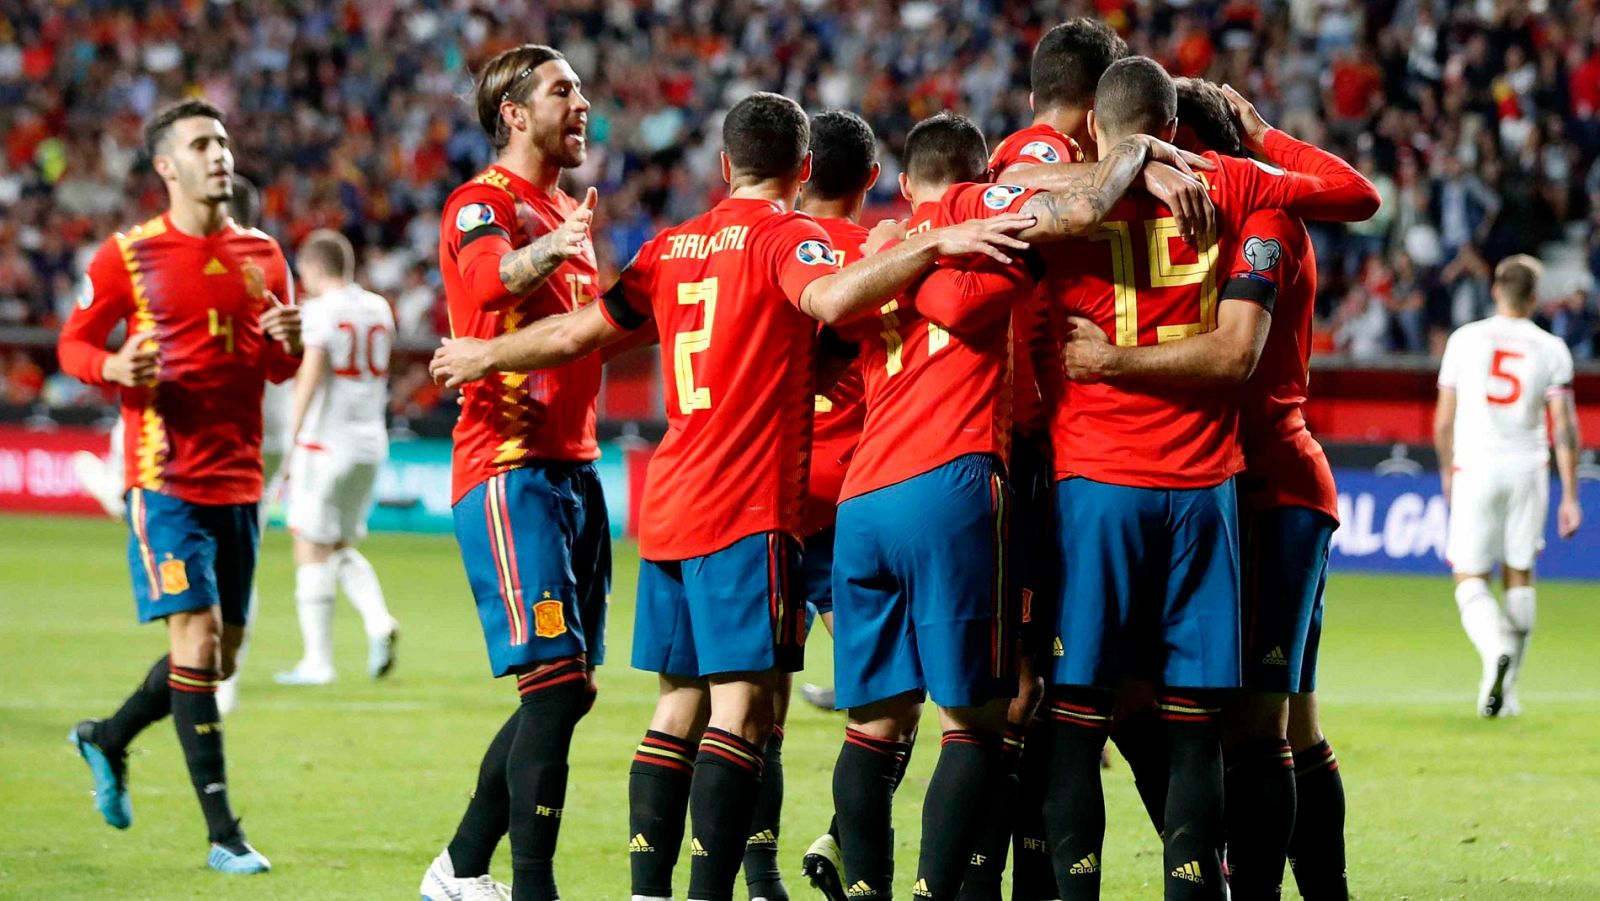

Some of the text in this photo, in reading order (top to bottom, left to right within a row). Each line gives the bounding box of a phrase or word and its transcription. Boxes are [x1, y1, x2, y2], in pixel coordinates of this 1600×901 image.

[1088, 216, 1219, 347] 19
[208, 311, 234, 352] 4
[333, 322, 393, 377] 10
[674, 276, 719, 415] 2
[1487, 349, 1525, 404] 5
